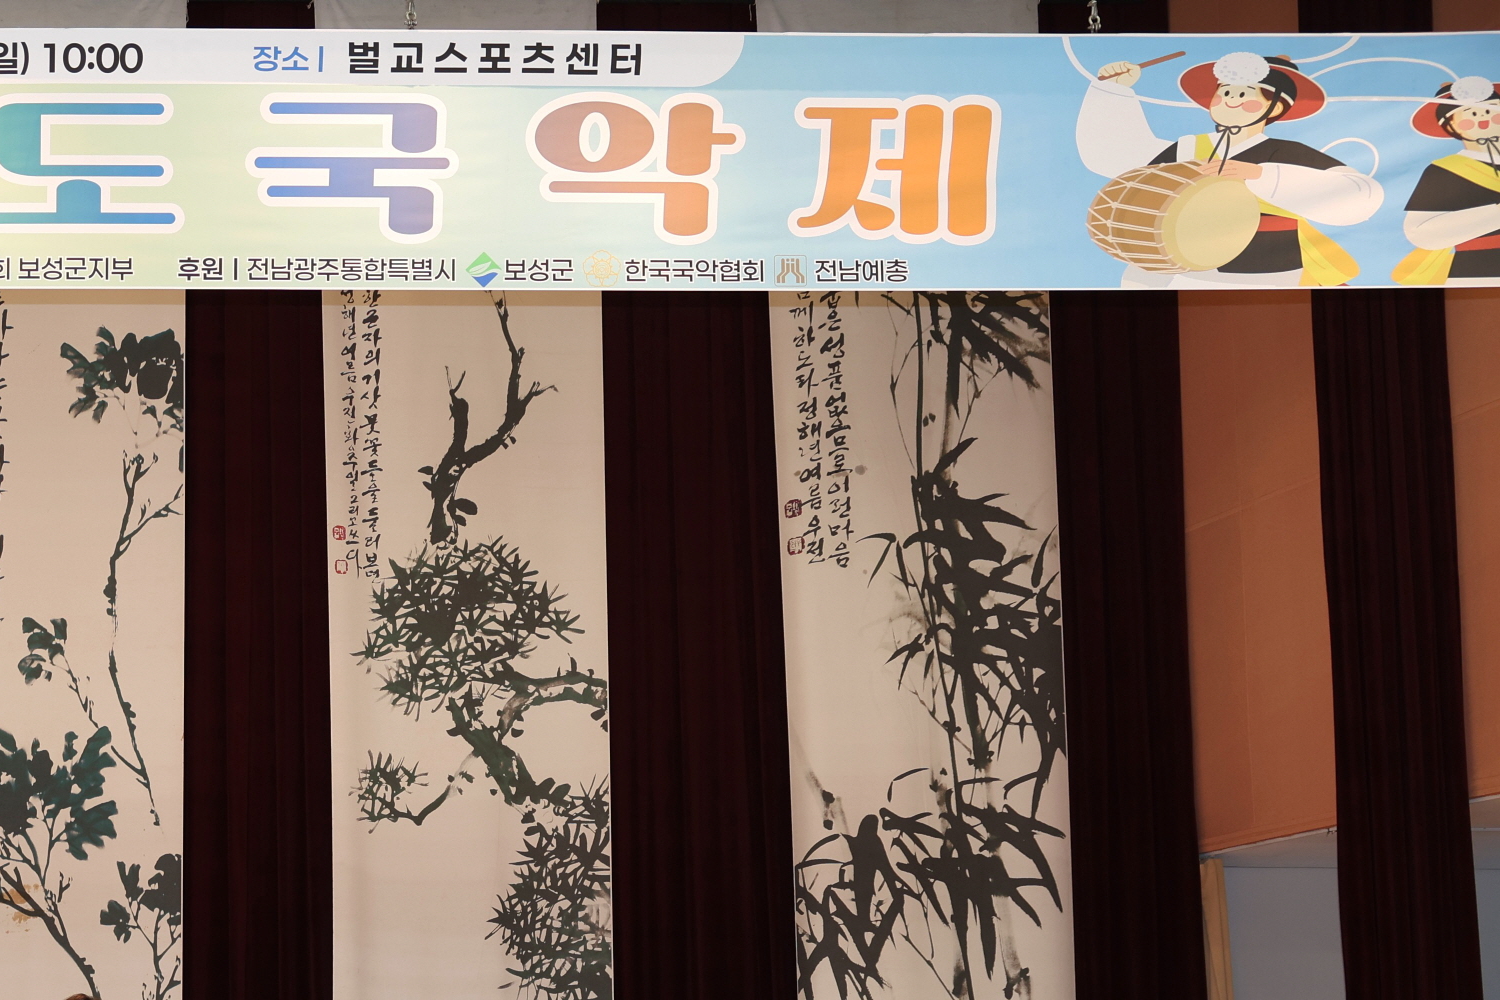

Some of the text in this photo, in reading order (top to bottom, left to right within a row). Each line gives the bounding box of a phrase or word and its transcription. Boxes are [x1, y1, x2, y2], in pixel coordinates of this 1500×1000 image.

[44, 43, 143, 73] 10:00
[255, 47, 308, 71] 장소
[349, 42, 641, 75] 벌교스포츠센터
[19, 258, 133, 280] 보성군지부
[178, 257, 222, 280] 후원
[248, 258, 455, 281] 전남광주통합특별시
[505, 260, 573, 281] 보성군
[626, 260, 763, 282] 한국국악협회
[816, 259, 908, 282] 전남예총
